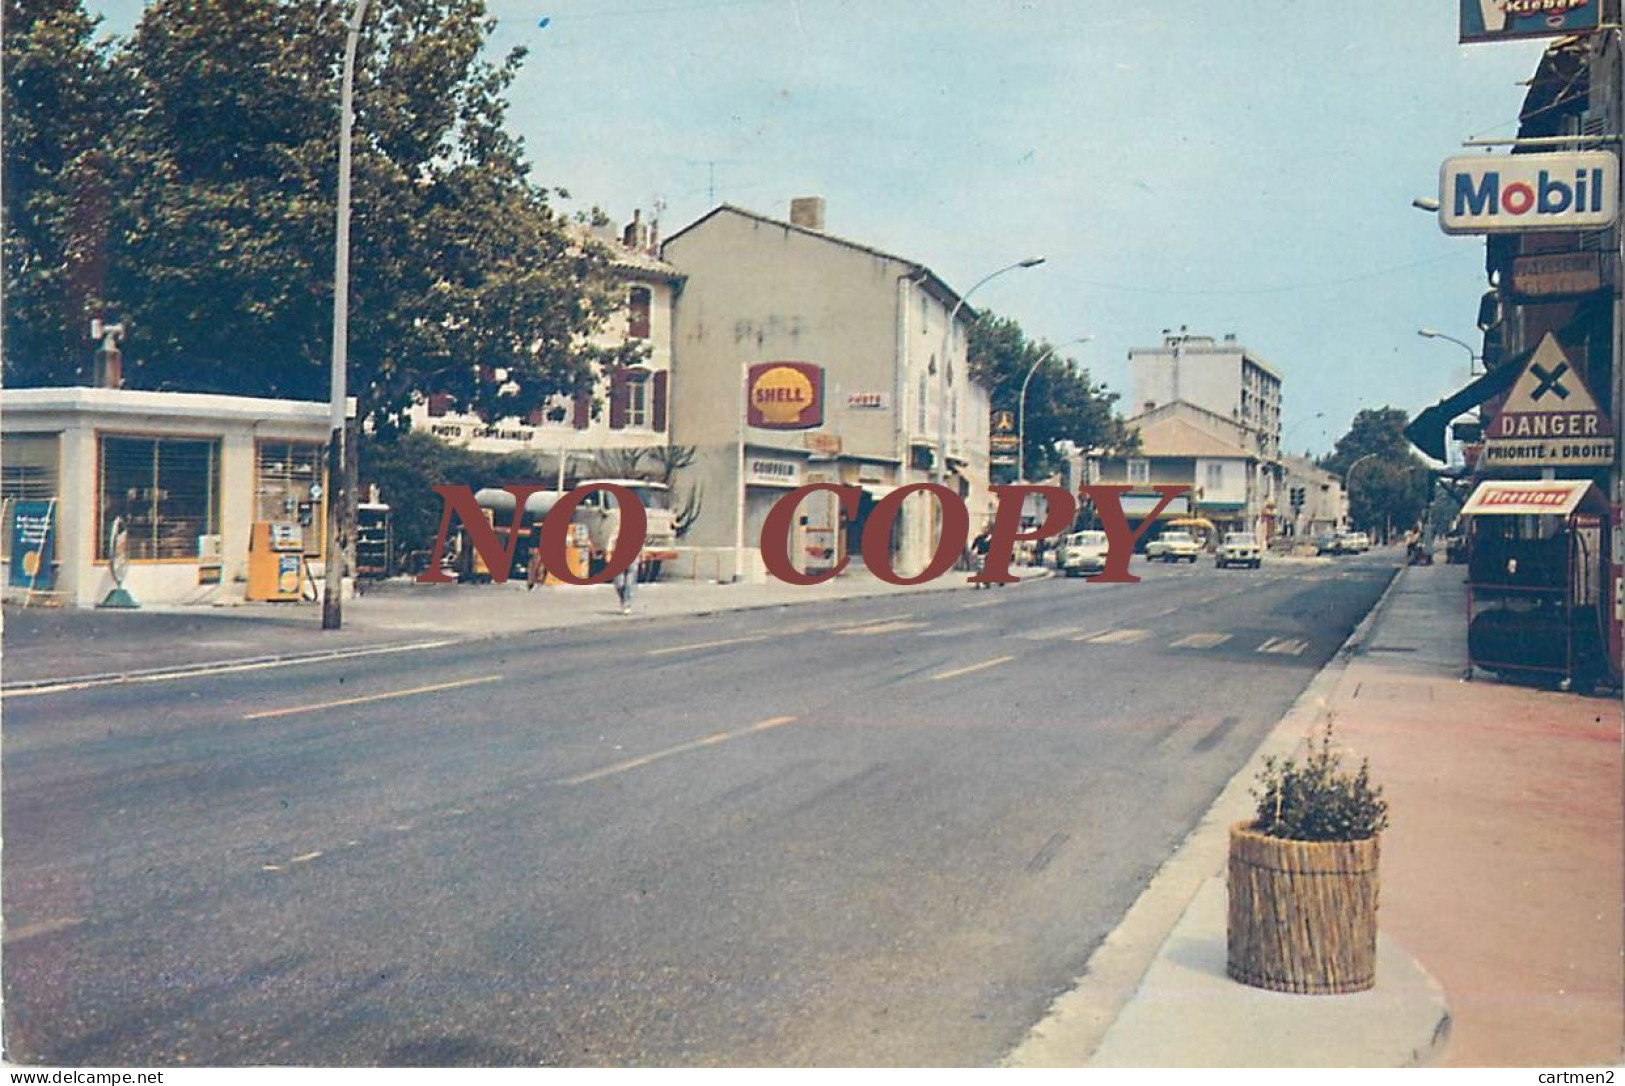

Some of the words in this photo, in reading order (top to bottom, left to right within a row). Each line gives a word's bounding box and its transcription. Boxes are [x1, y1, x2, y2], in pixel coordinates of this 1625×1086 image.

[1455, 169, 1602, 216] Mobil
[757, 388, 803, 403] SHELL
[432, 425, 461, 437] PHOTO
[1503, 415, 1596, 434] DANGER
[1488, 444, 1544, 459] PRIORITÉ
[1563, 444, 1611, 457] DROITE
[1484, 491, 1565, 505] Firestone
